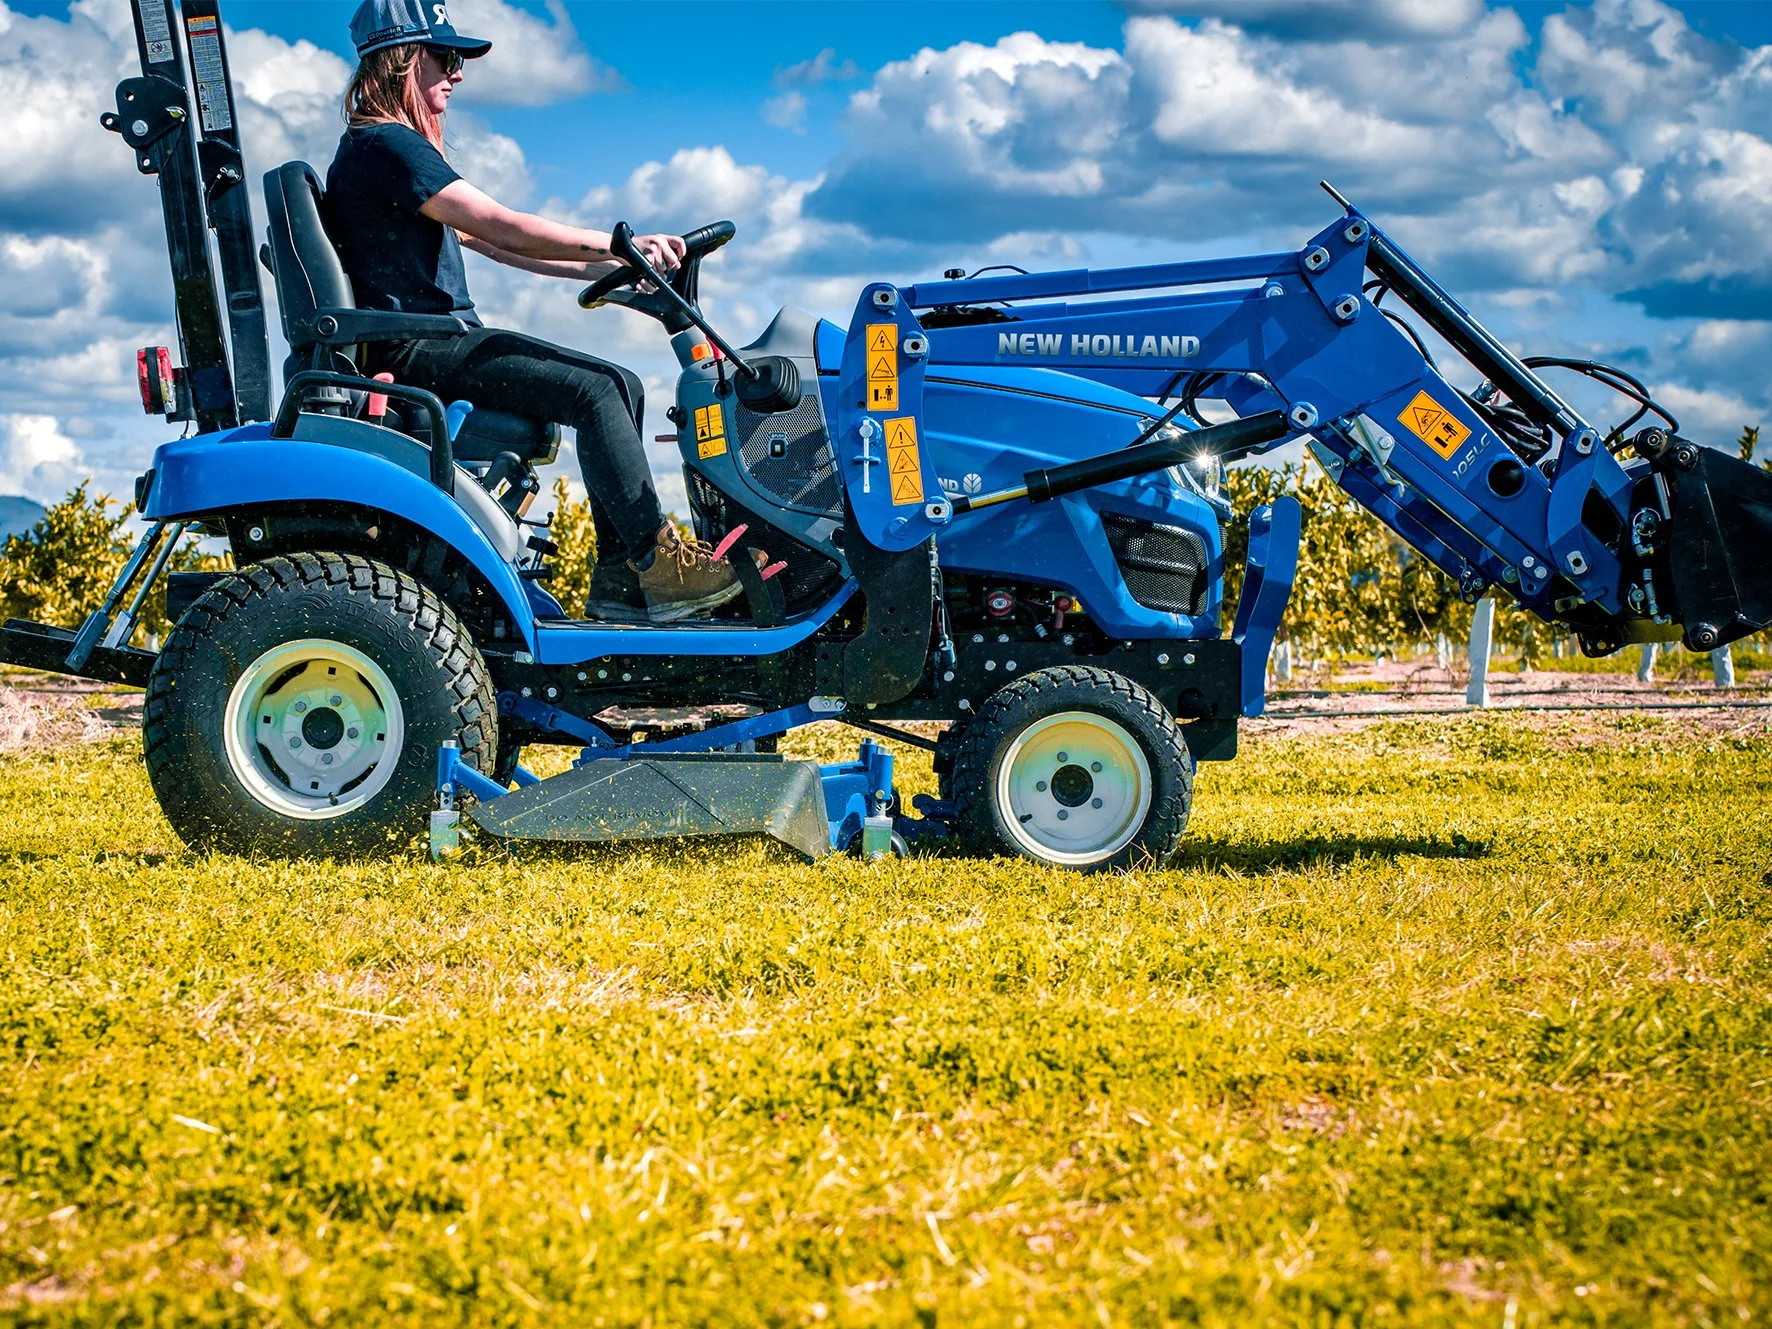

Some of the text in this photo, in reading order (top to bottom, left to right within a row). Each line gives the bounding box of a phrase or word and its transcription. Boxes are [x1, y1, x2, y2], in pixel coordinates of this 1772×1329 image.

[998, 333, 1200, 358] NEW HOLLAND
[1452, 432, 1491, 480] 105LC
